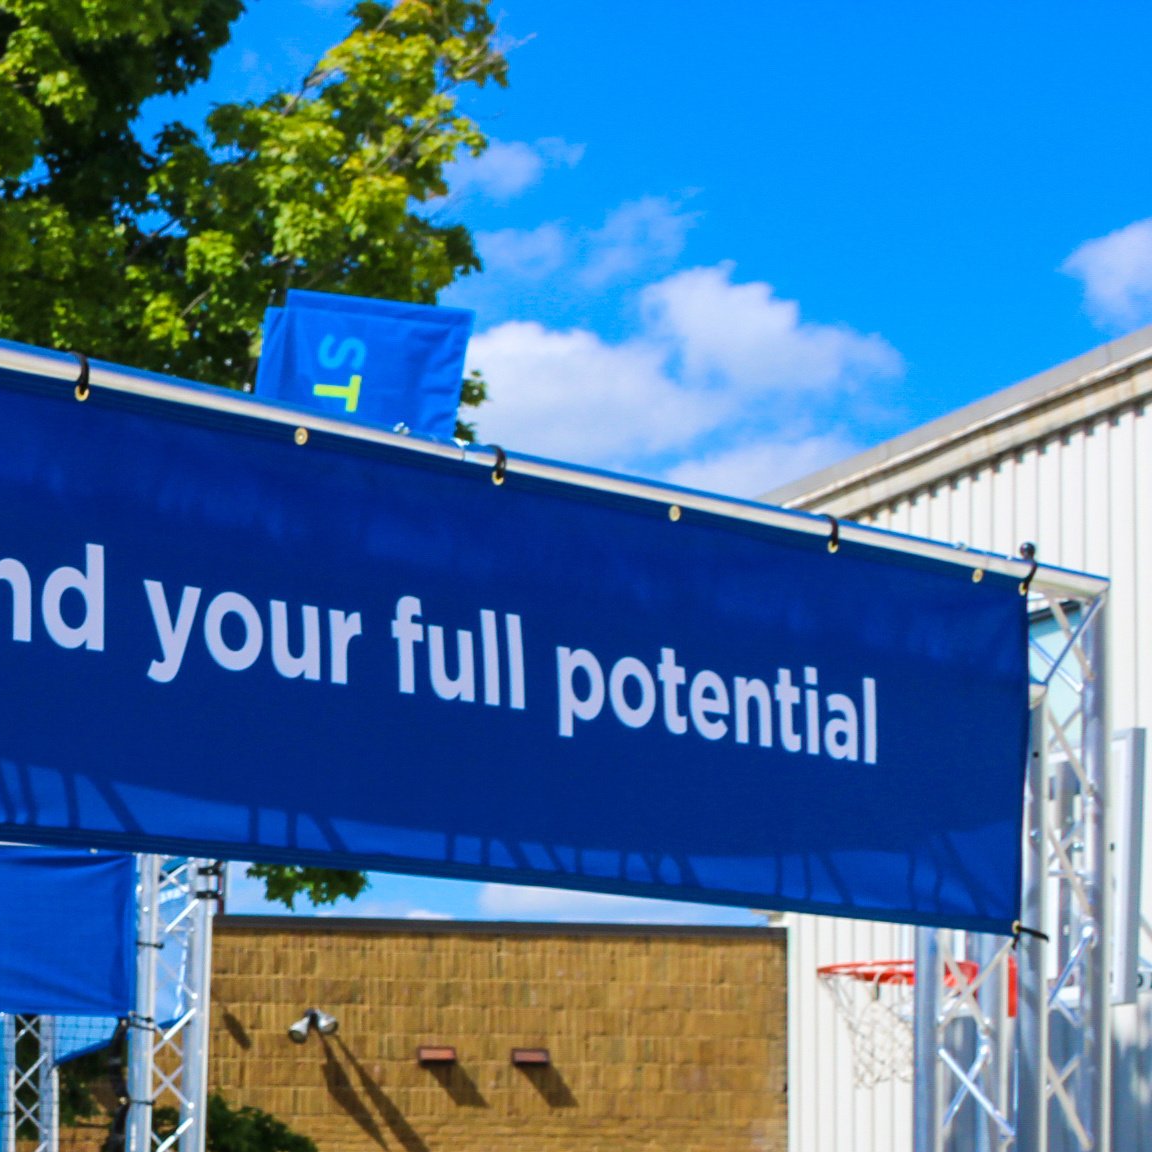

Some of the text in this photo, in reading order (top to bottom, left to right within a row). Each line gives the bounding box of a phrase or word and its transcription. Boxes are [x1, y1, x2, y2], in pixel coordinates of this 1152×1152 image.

[143, 579, 362, 685] your
[391, 595, 526, 710] full
[556, 646, 878, 765] potential
